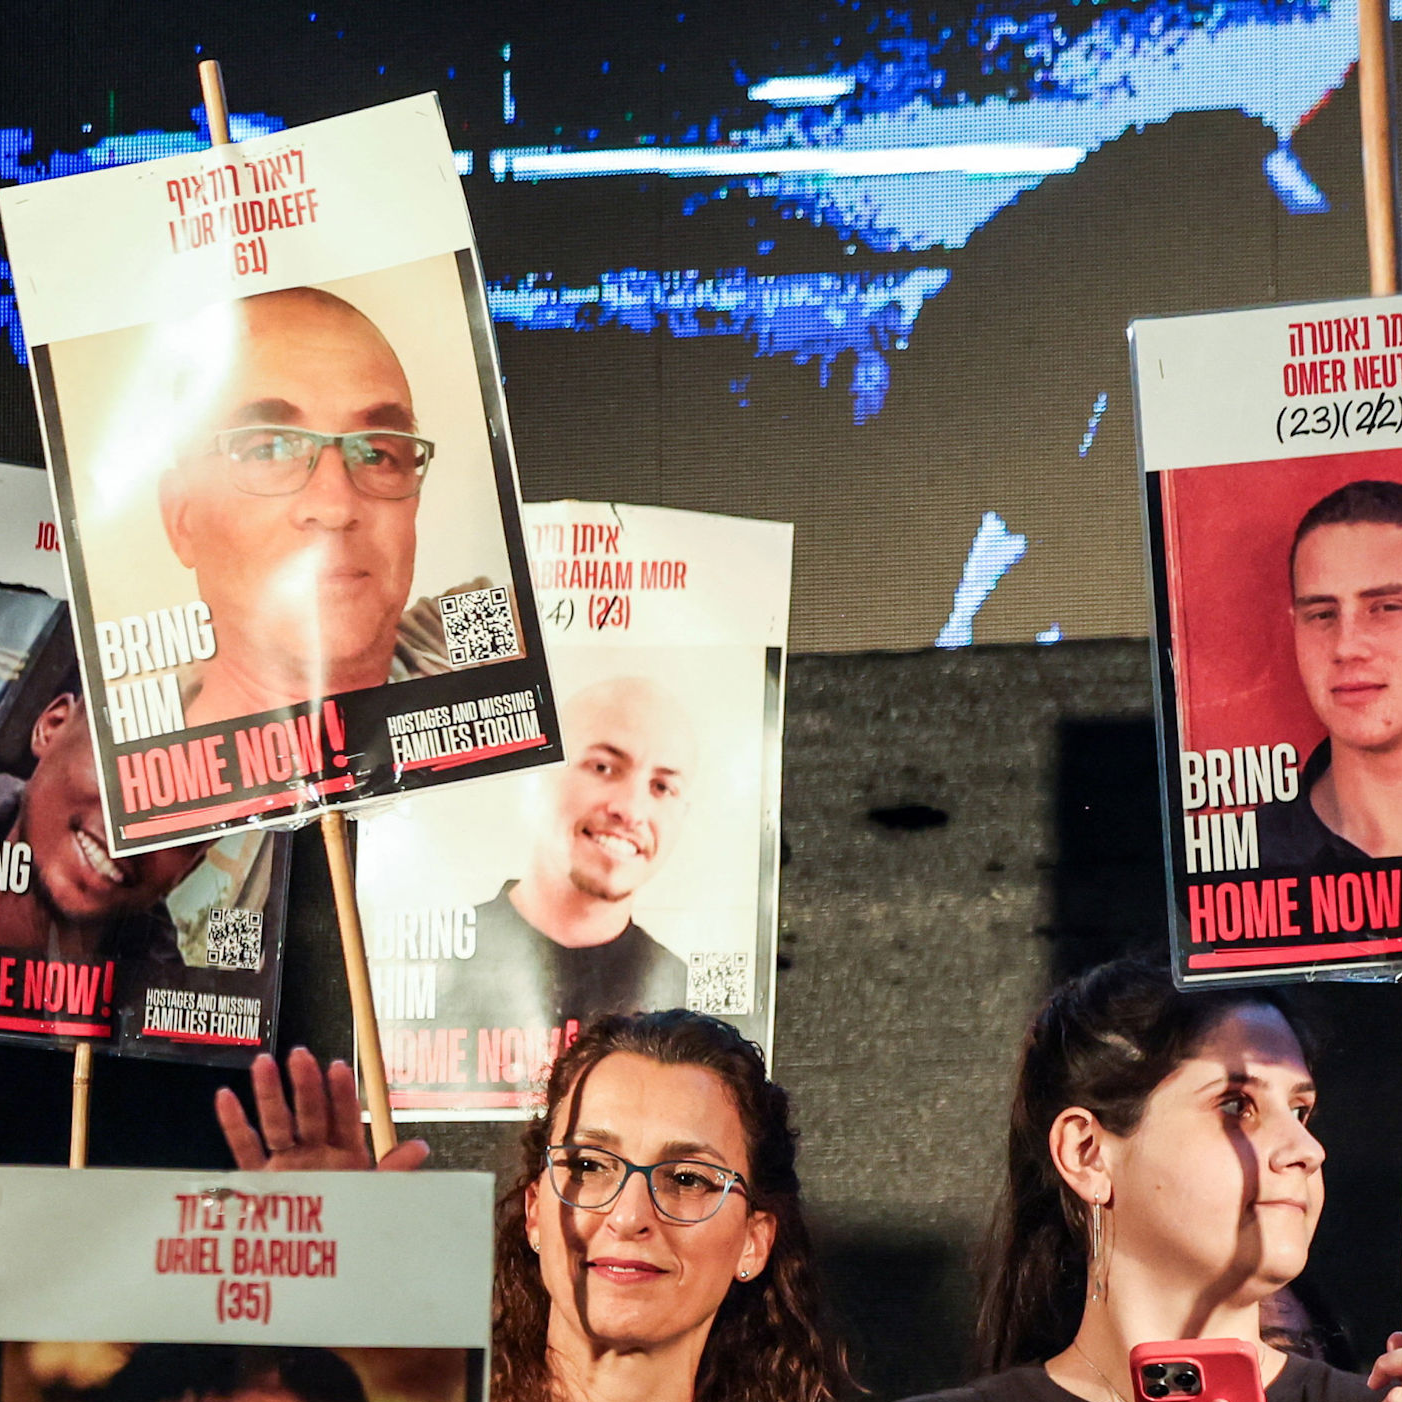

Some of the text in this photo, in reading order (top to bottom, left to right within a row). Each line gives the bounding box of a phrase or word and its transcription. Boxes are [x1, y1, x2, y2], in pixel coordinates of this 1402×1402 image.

[244, 148, 306, 194] ליאור
[1288, 316, 1370, 358] נאוטרה
[1283, 358, 1348, 398] OMER
[572, 523, 619, 556] איתן
[640, 560, 687, 591] MOR
[95, 600, 218, 681] BRING
[107, 672, 186, 745] HIM
[386, 690, 536, 738] HOSTAGES AND MISSING
[116, 699, 350, 814] HOME NOW!
[391, 711, 543, 766] FAMILIES FORUM
[1181, 743, 1299, 809] BRING
[1185, 811, 1260, 874] HIM
[1188, 878, 1301, 943] HOME
[23, 959, 115, 1019] NOW!
[145, 986, 262, 1018] HOSTAGES AND MISSING
[144, 1003, 261, 1041] FAMILIES FORUM
[156, 1237, 338, 1278] URIEL BARUCH
[216, 1279, 272, 1326] (35)
